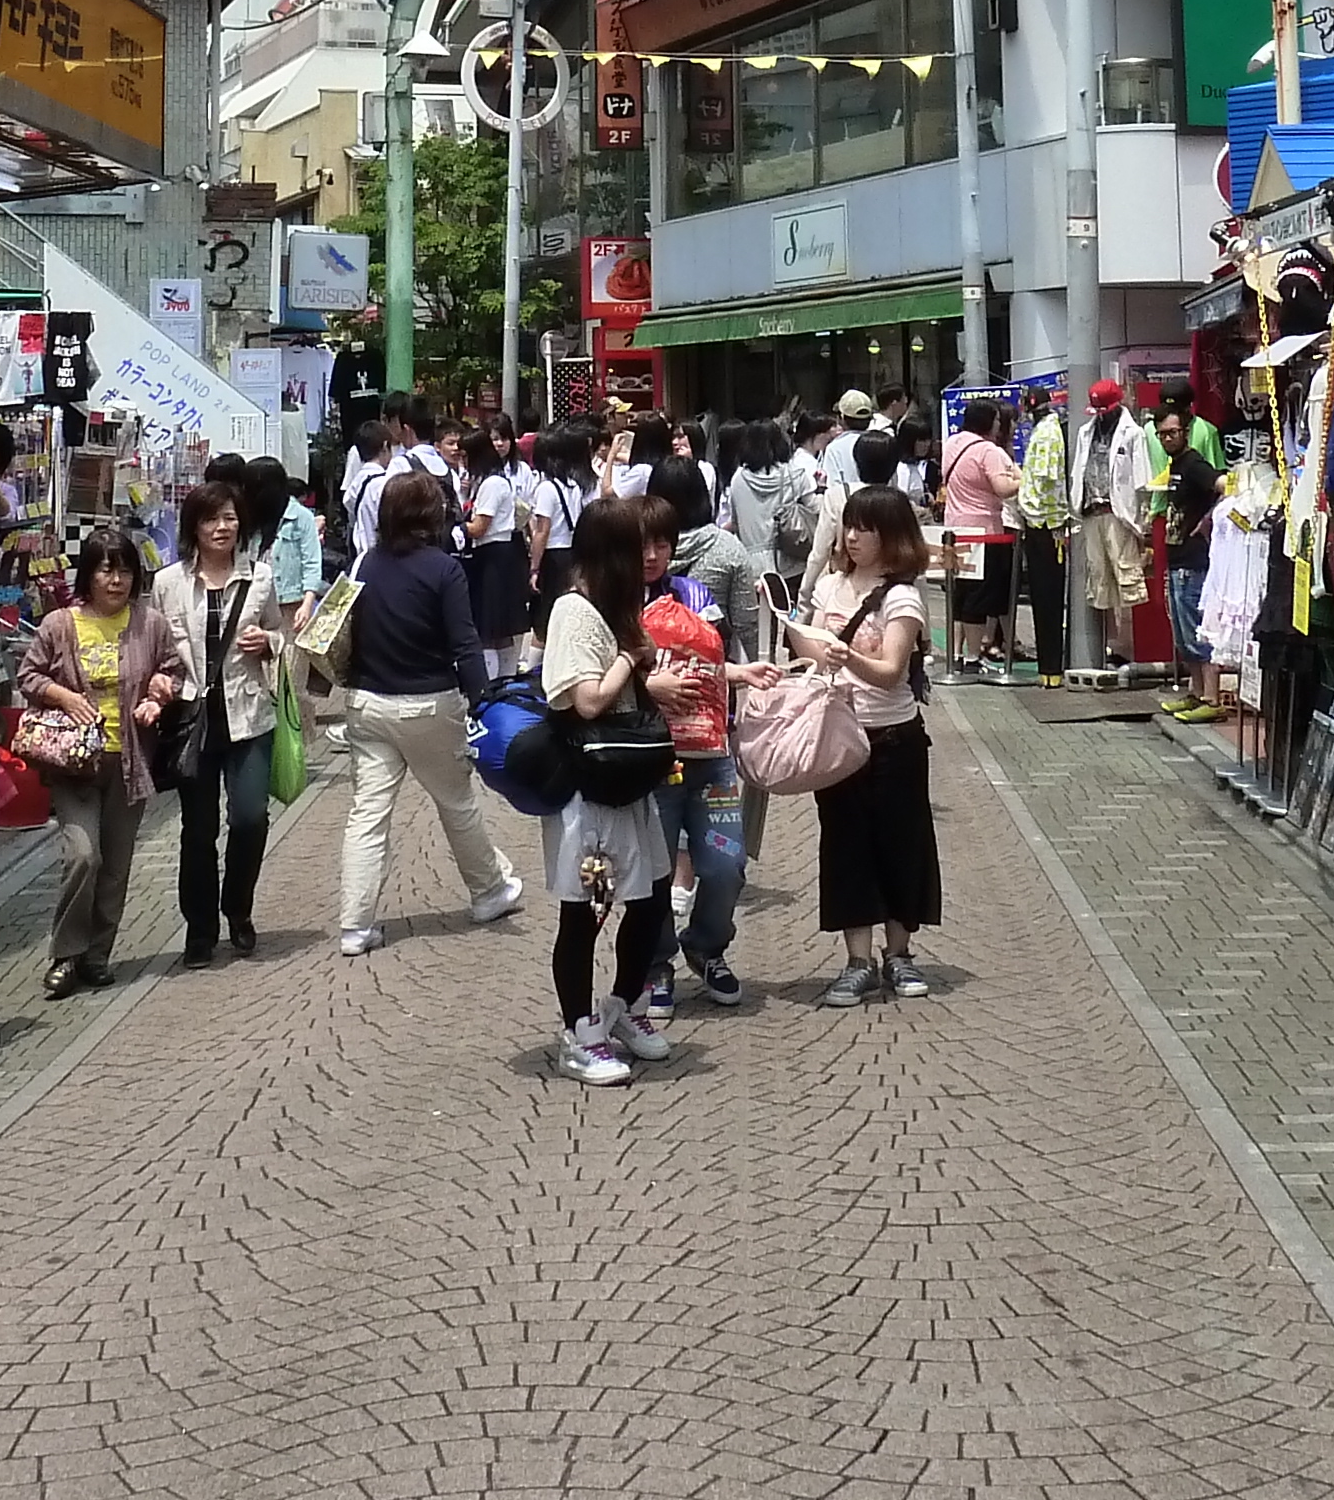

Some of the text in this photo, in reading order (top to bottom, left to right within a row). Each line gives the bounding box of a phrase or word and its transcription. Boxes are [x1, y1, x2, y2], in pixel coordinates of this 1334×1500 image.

[606, 96, 633, 116] ドナ
[609, 130, 631, 144] 2F
[593, 244, 612, 256] 2F
[140, 340, 171, 366] POP
[171, 365, 211, 398] LAND
